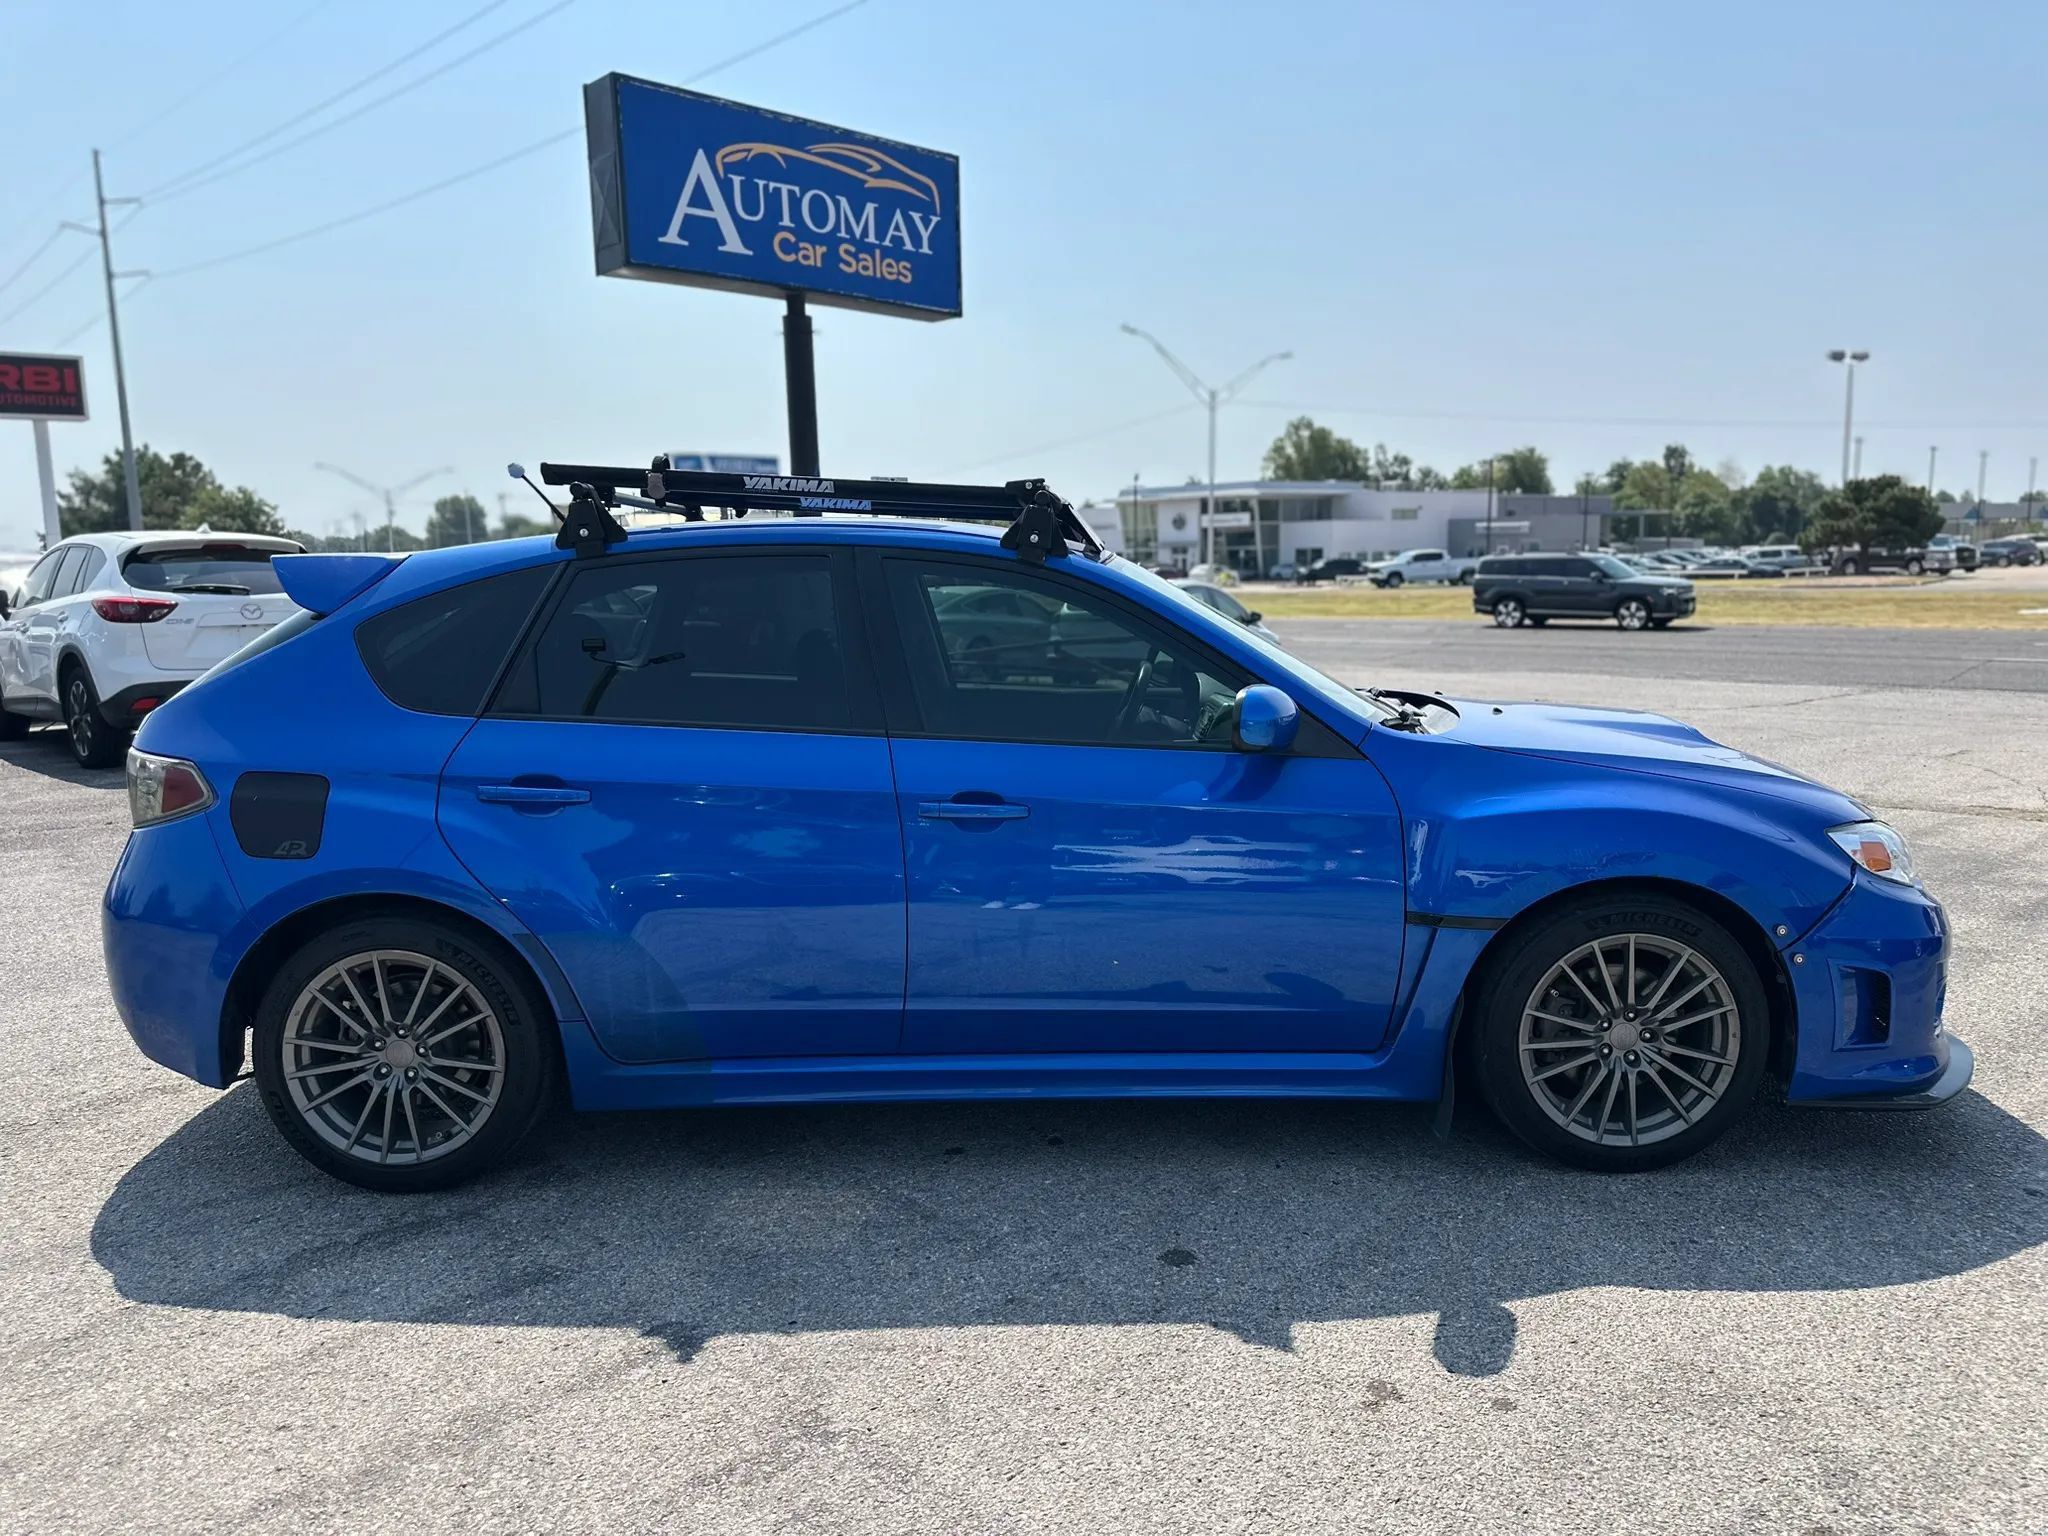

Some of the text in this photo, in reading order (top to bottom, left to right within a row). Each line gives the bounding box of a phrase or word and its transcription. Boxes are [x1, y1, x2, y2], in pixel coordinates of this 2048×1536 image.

[658, 148, 941, 255] AUTOMAY
[773, 232, 912, 284] Car Sales
[743, 476, 835, 493] YAKIMA
[800, 497, 872, 510] YAKIMA
